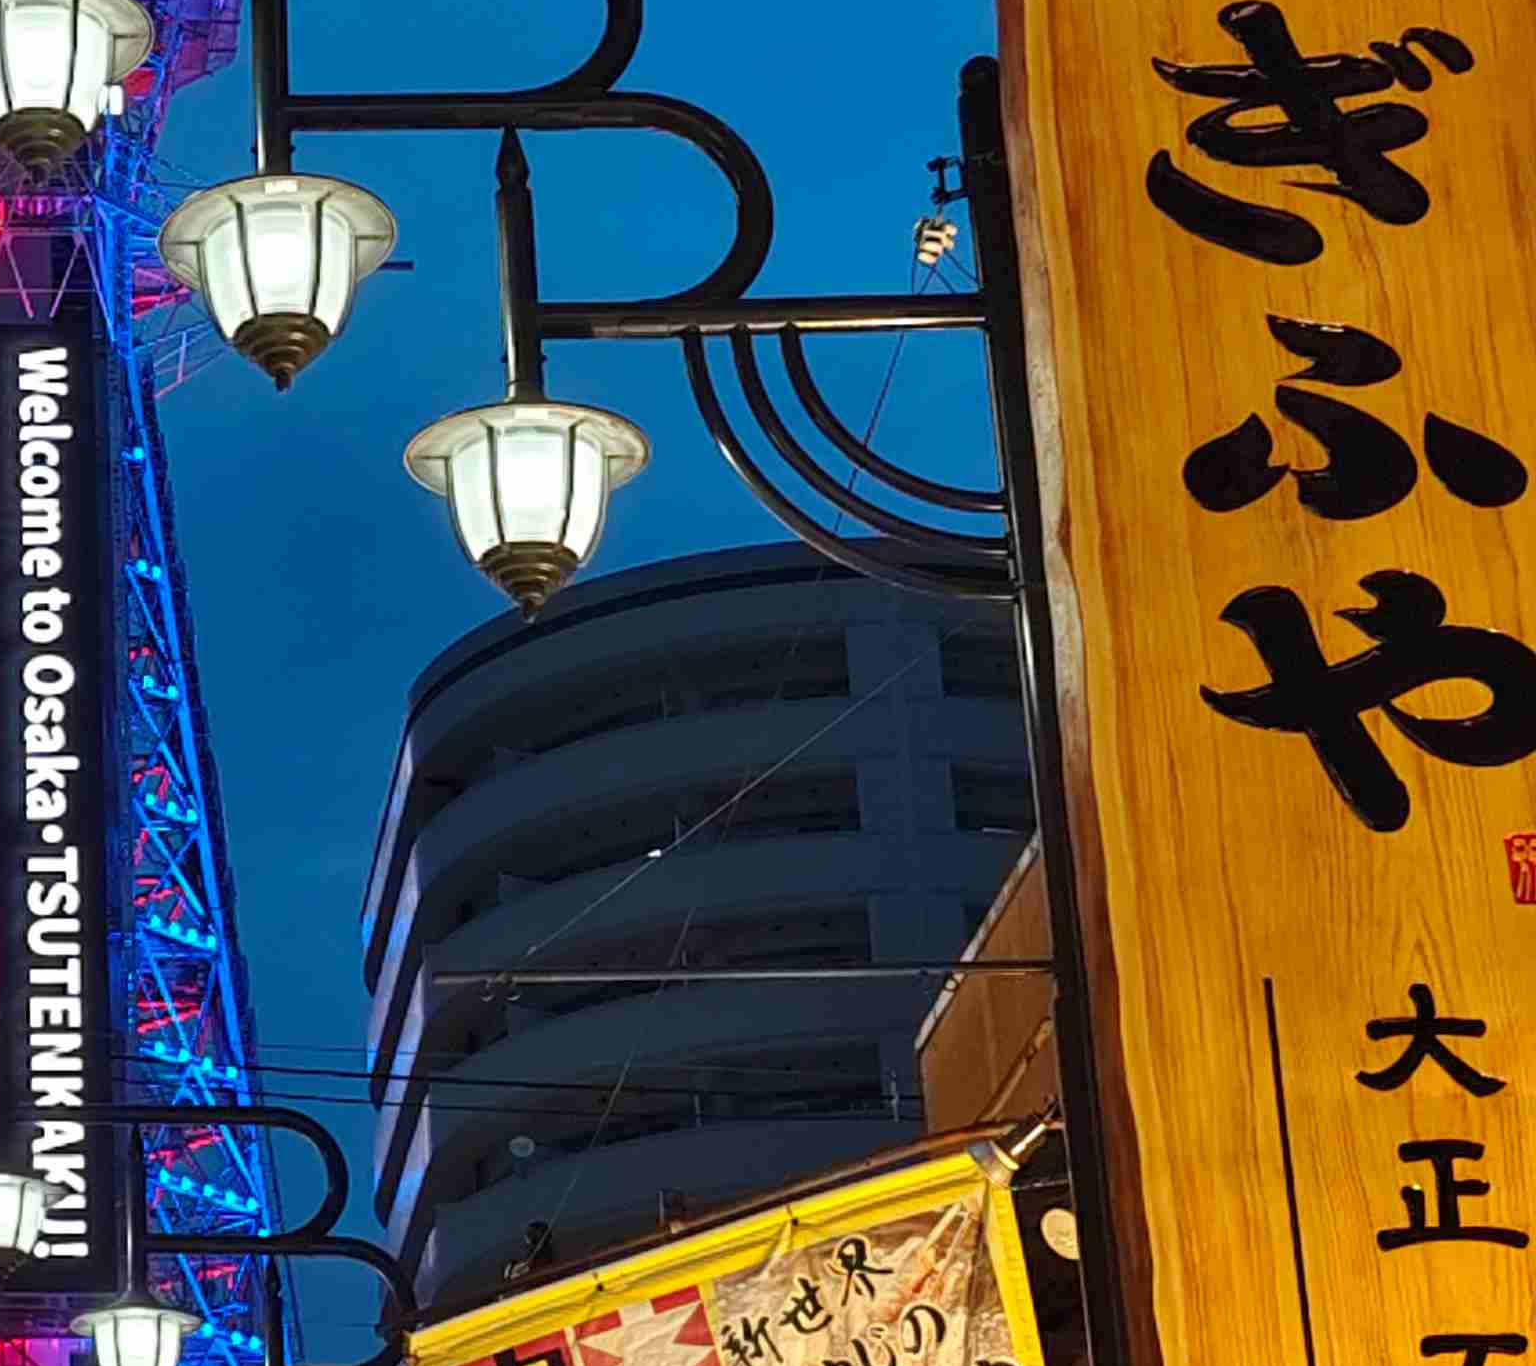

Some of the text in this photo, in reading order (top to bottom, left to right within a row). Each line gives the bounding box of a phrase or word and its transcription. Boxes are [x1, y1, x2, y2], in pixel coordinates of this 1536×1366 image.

[17, 346, 74, 579] Welcome
[1146, 0, 1536, 832] ぎふや
[21, 586, 72, 644] to
